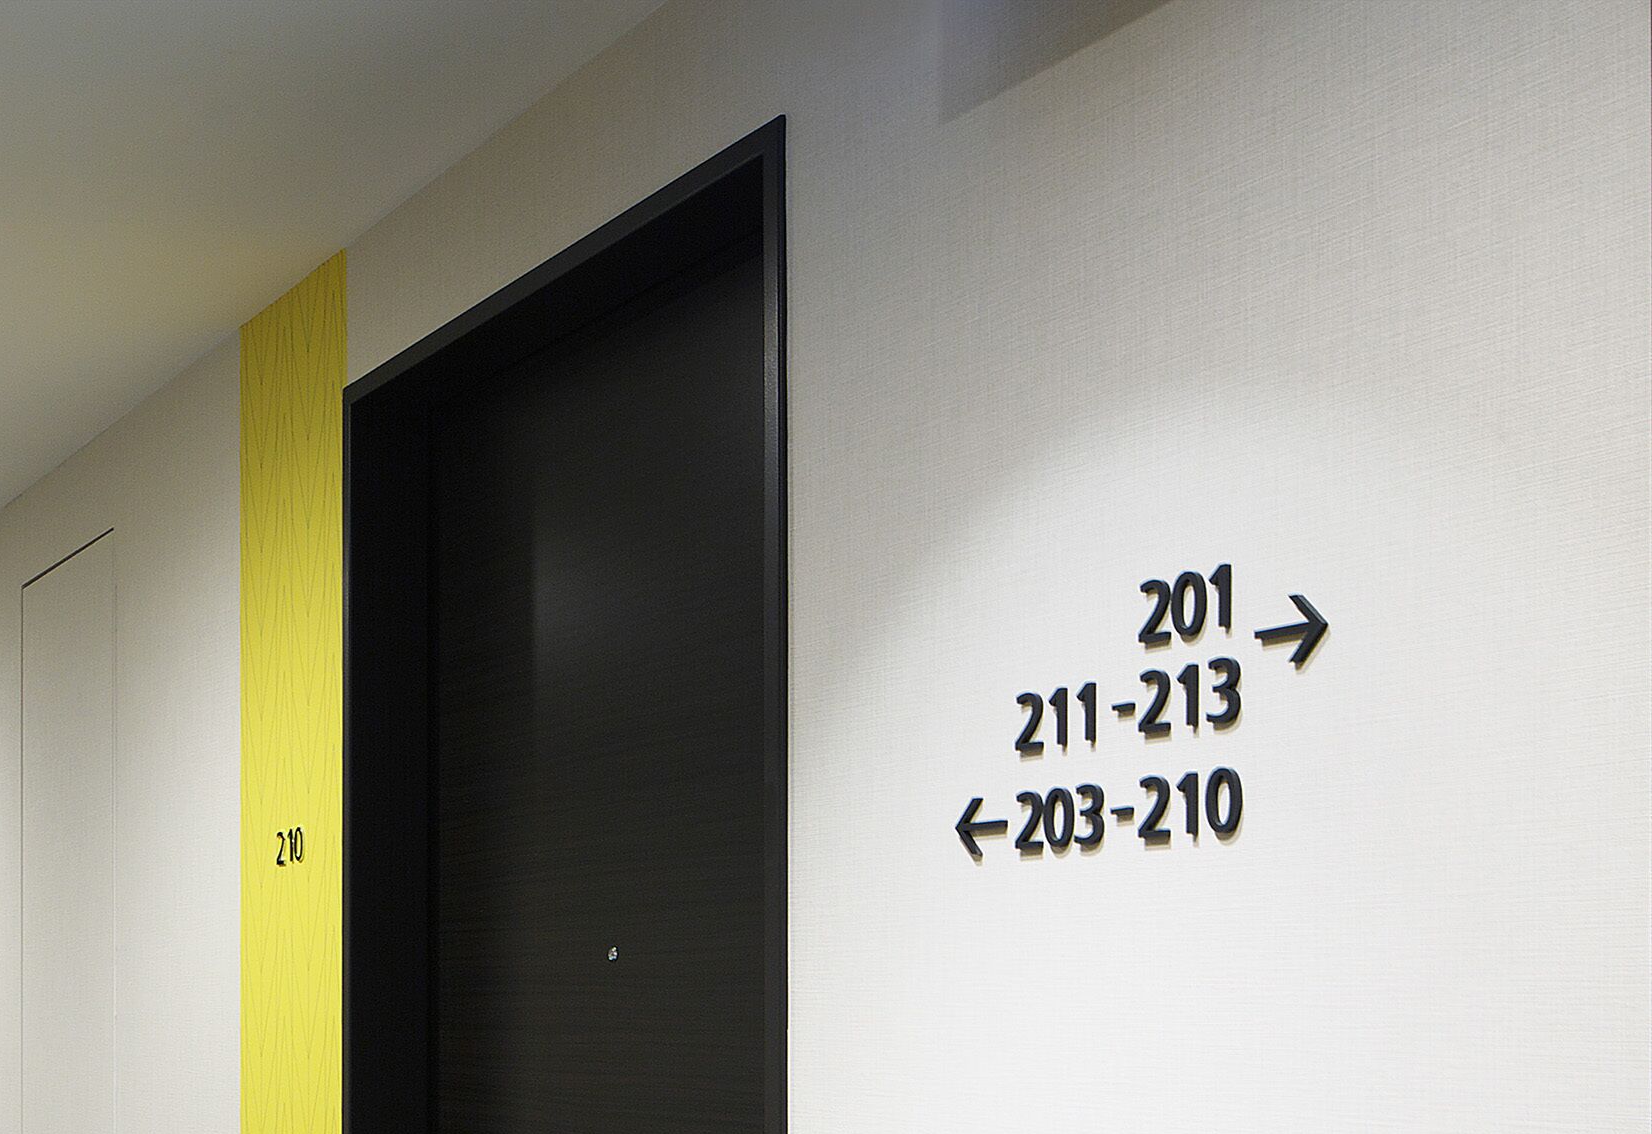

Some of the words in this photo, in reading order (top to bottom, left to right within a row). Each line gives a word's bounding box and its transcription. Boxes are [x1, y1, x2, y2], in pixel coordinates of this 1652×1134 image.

[1137, 562, 1234, 646] 201
[1013, 655, 1243, 755] 211-213
[275, 826, 304, 867] 210
[1013, 766, 1245, 852] 203-210
